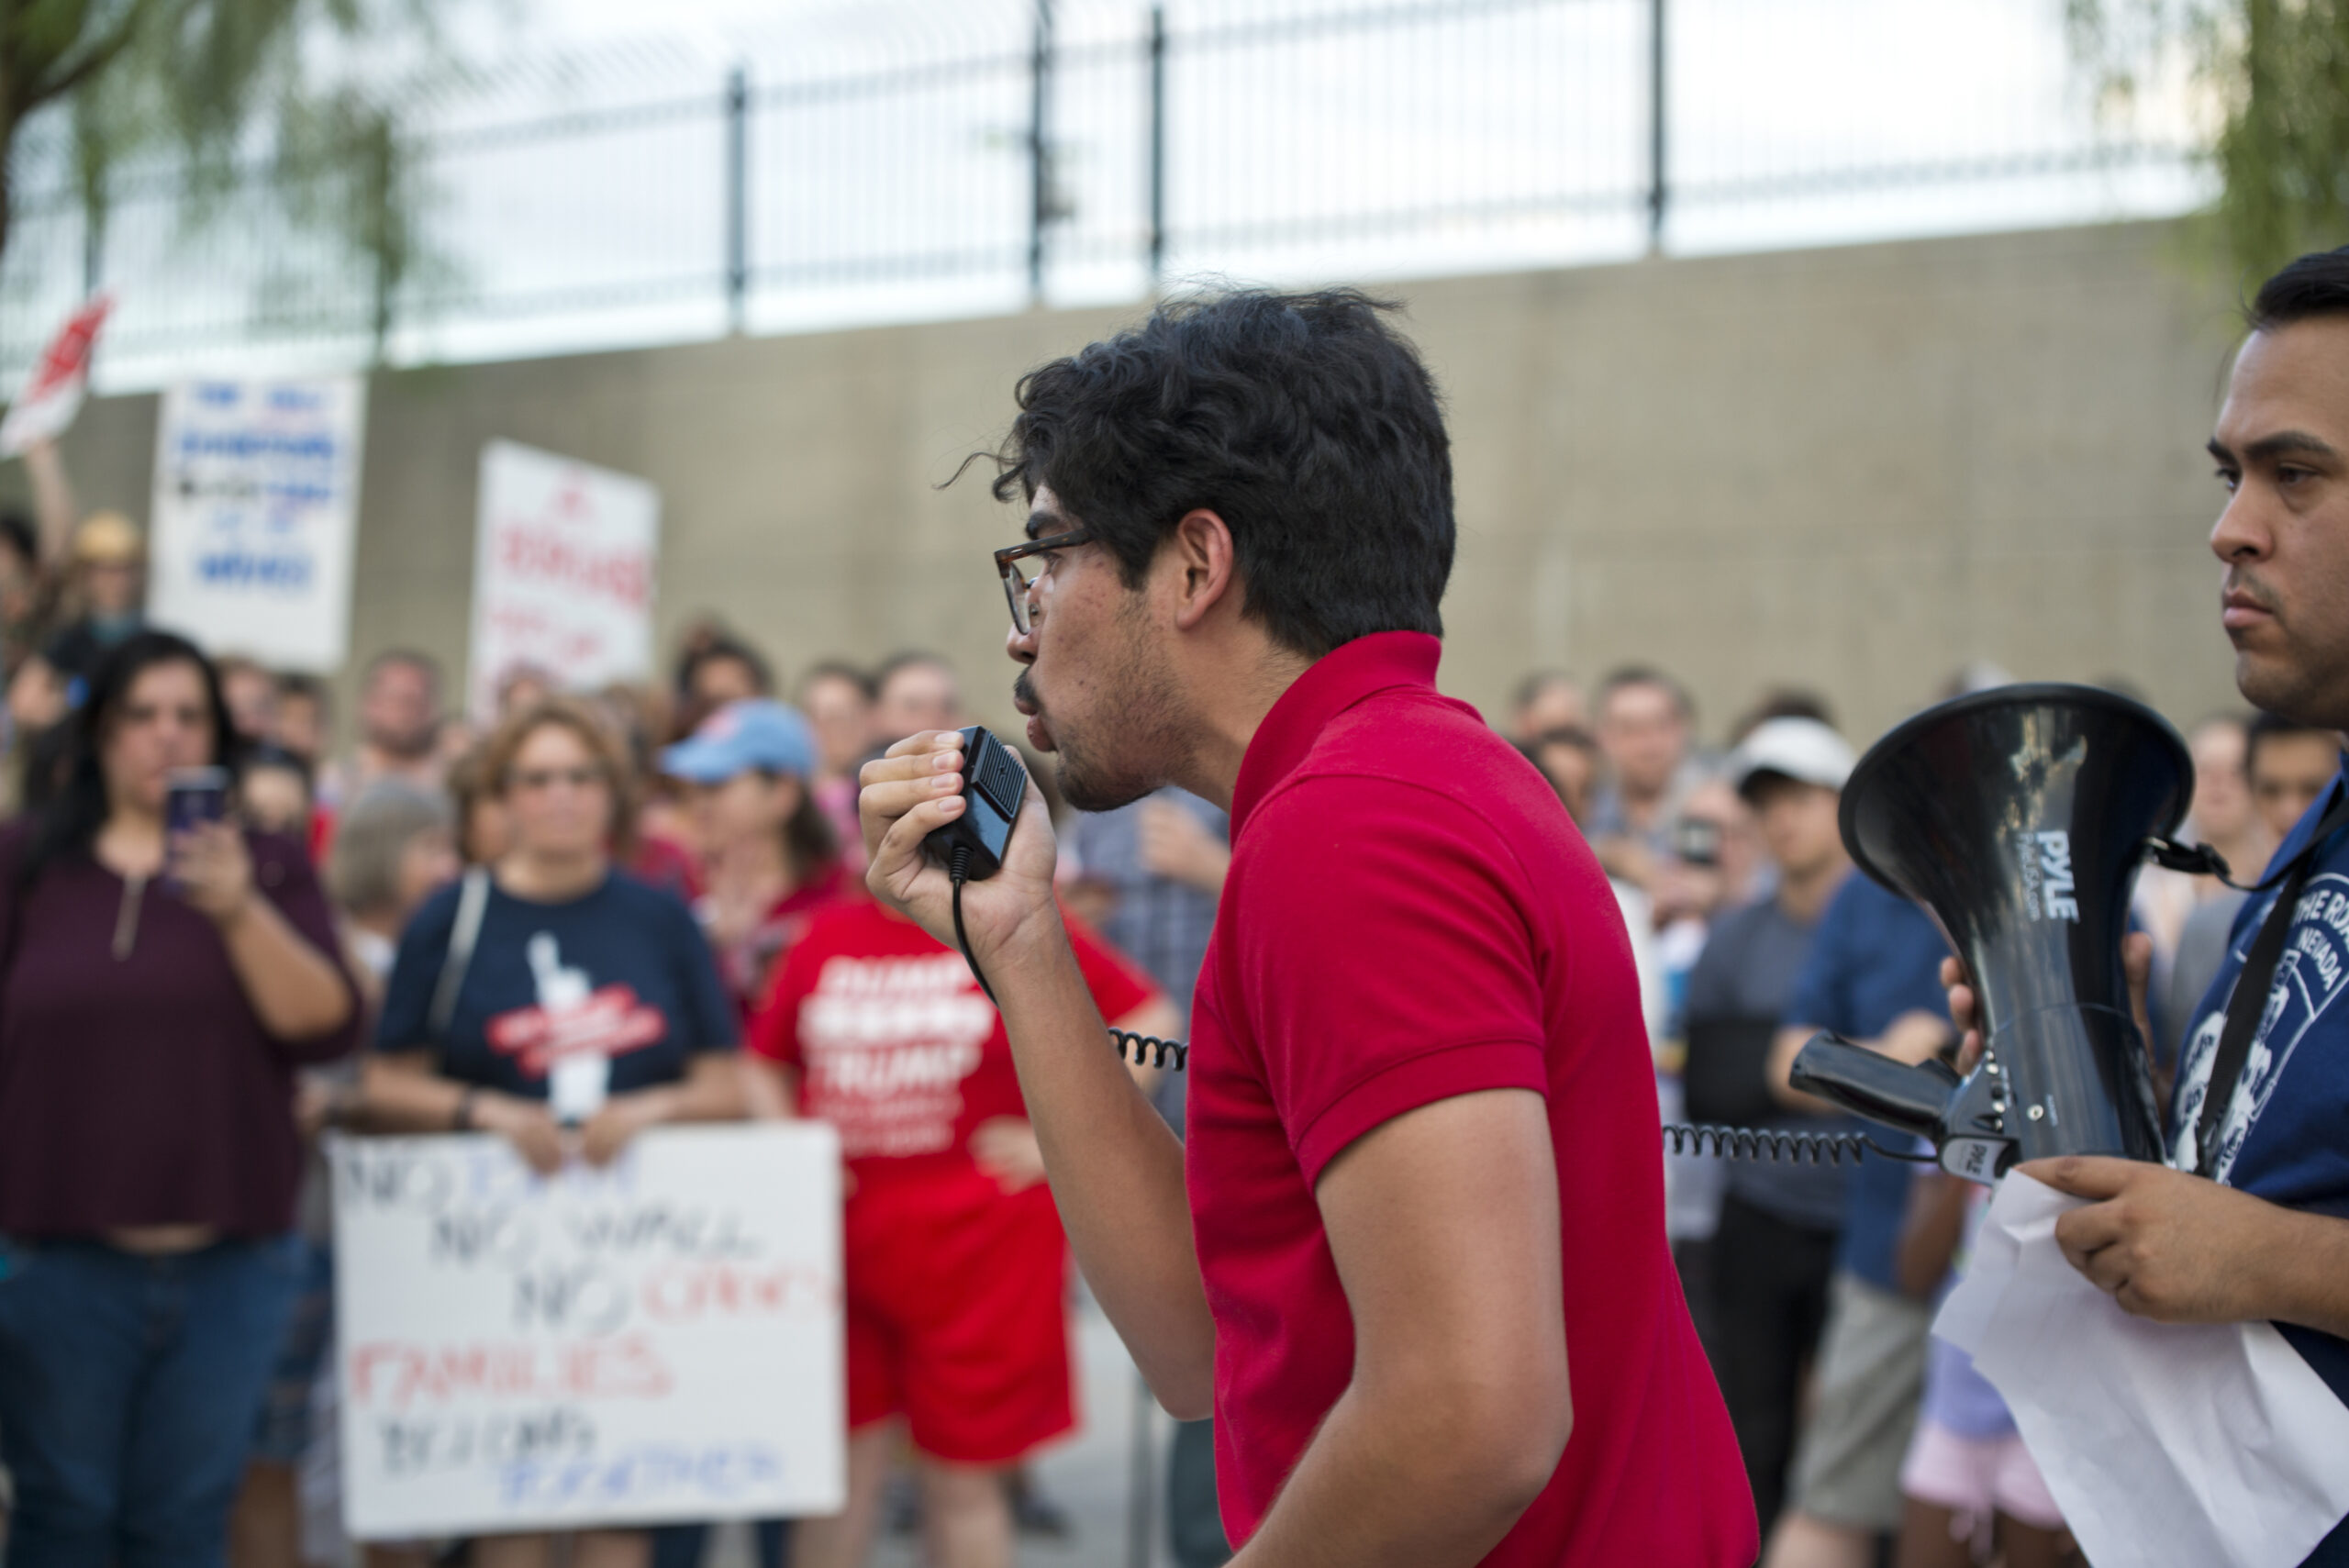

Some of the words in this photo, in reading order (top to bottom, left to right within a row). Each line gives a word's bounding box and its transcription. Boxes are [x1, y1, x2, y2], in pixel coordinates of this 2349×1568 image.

[2036, 830, 2080, 924] PYLE
[2296, 926, 2343, 992] NEVADA
[430, 1198, 534, 1266] NO
[512, 1264, 635, 1336] NO
[350, 1336, 677, 1413] FAMILIES
